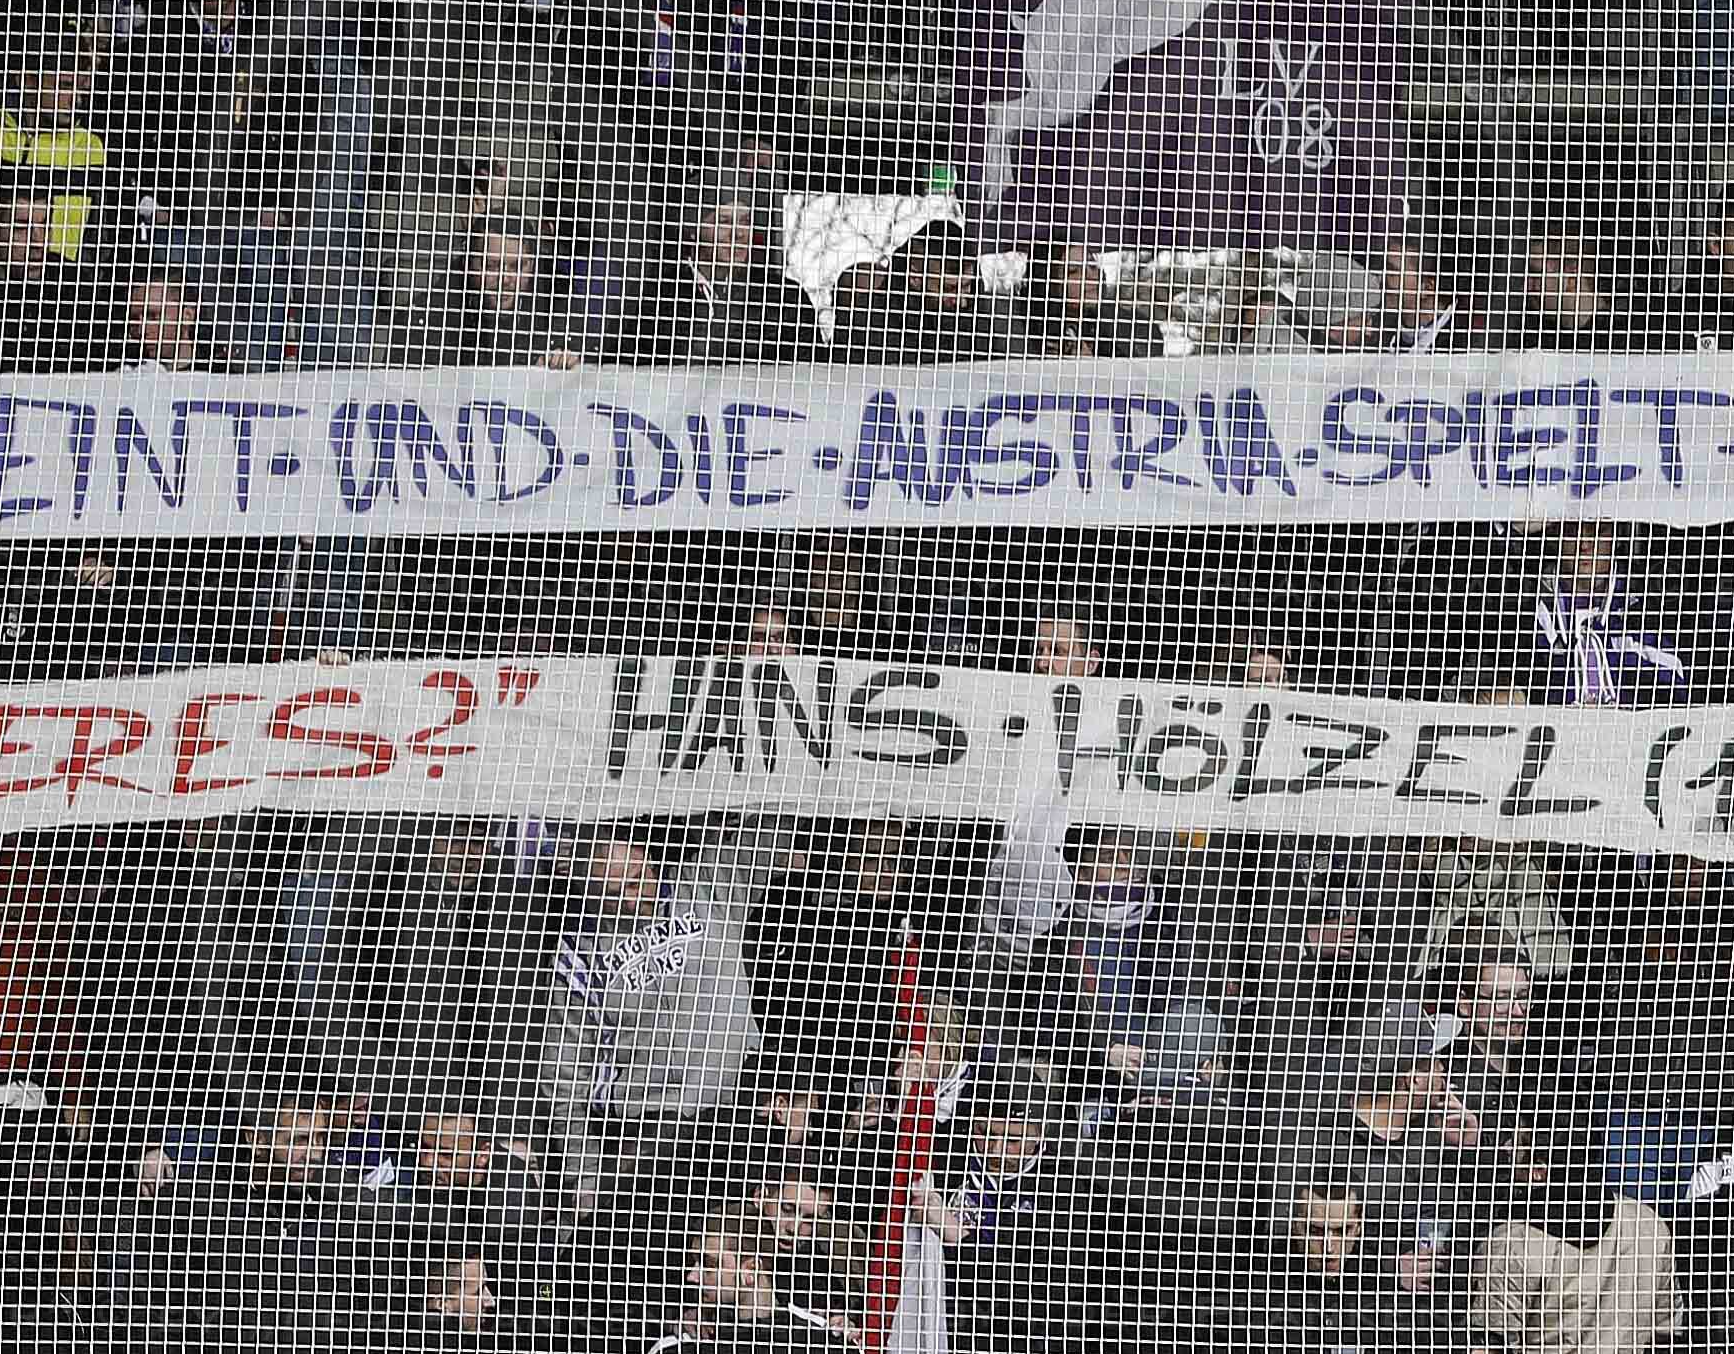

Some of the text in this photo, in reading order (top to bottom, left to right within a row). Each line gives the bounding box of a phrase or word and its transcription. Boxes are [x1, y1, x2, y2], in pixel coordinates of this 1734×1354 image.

[331, 399, 565, 513] UND
[587, 402, 808, 509] DIE
[844, 386, 1297, 508] AUSTRIA
[606, 658, 967, 780] HANS
[1051, 681, 1600, 818] HÖLZEL
